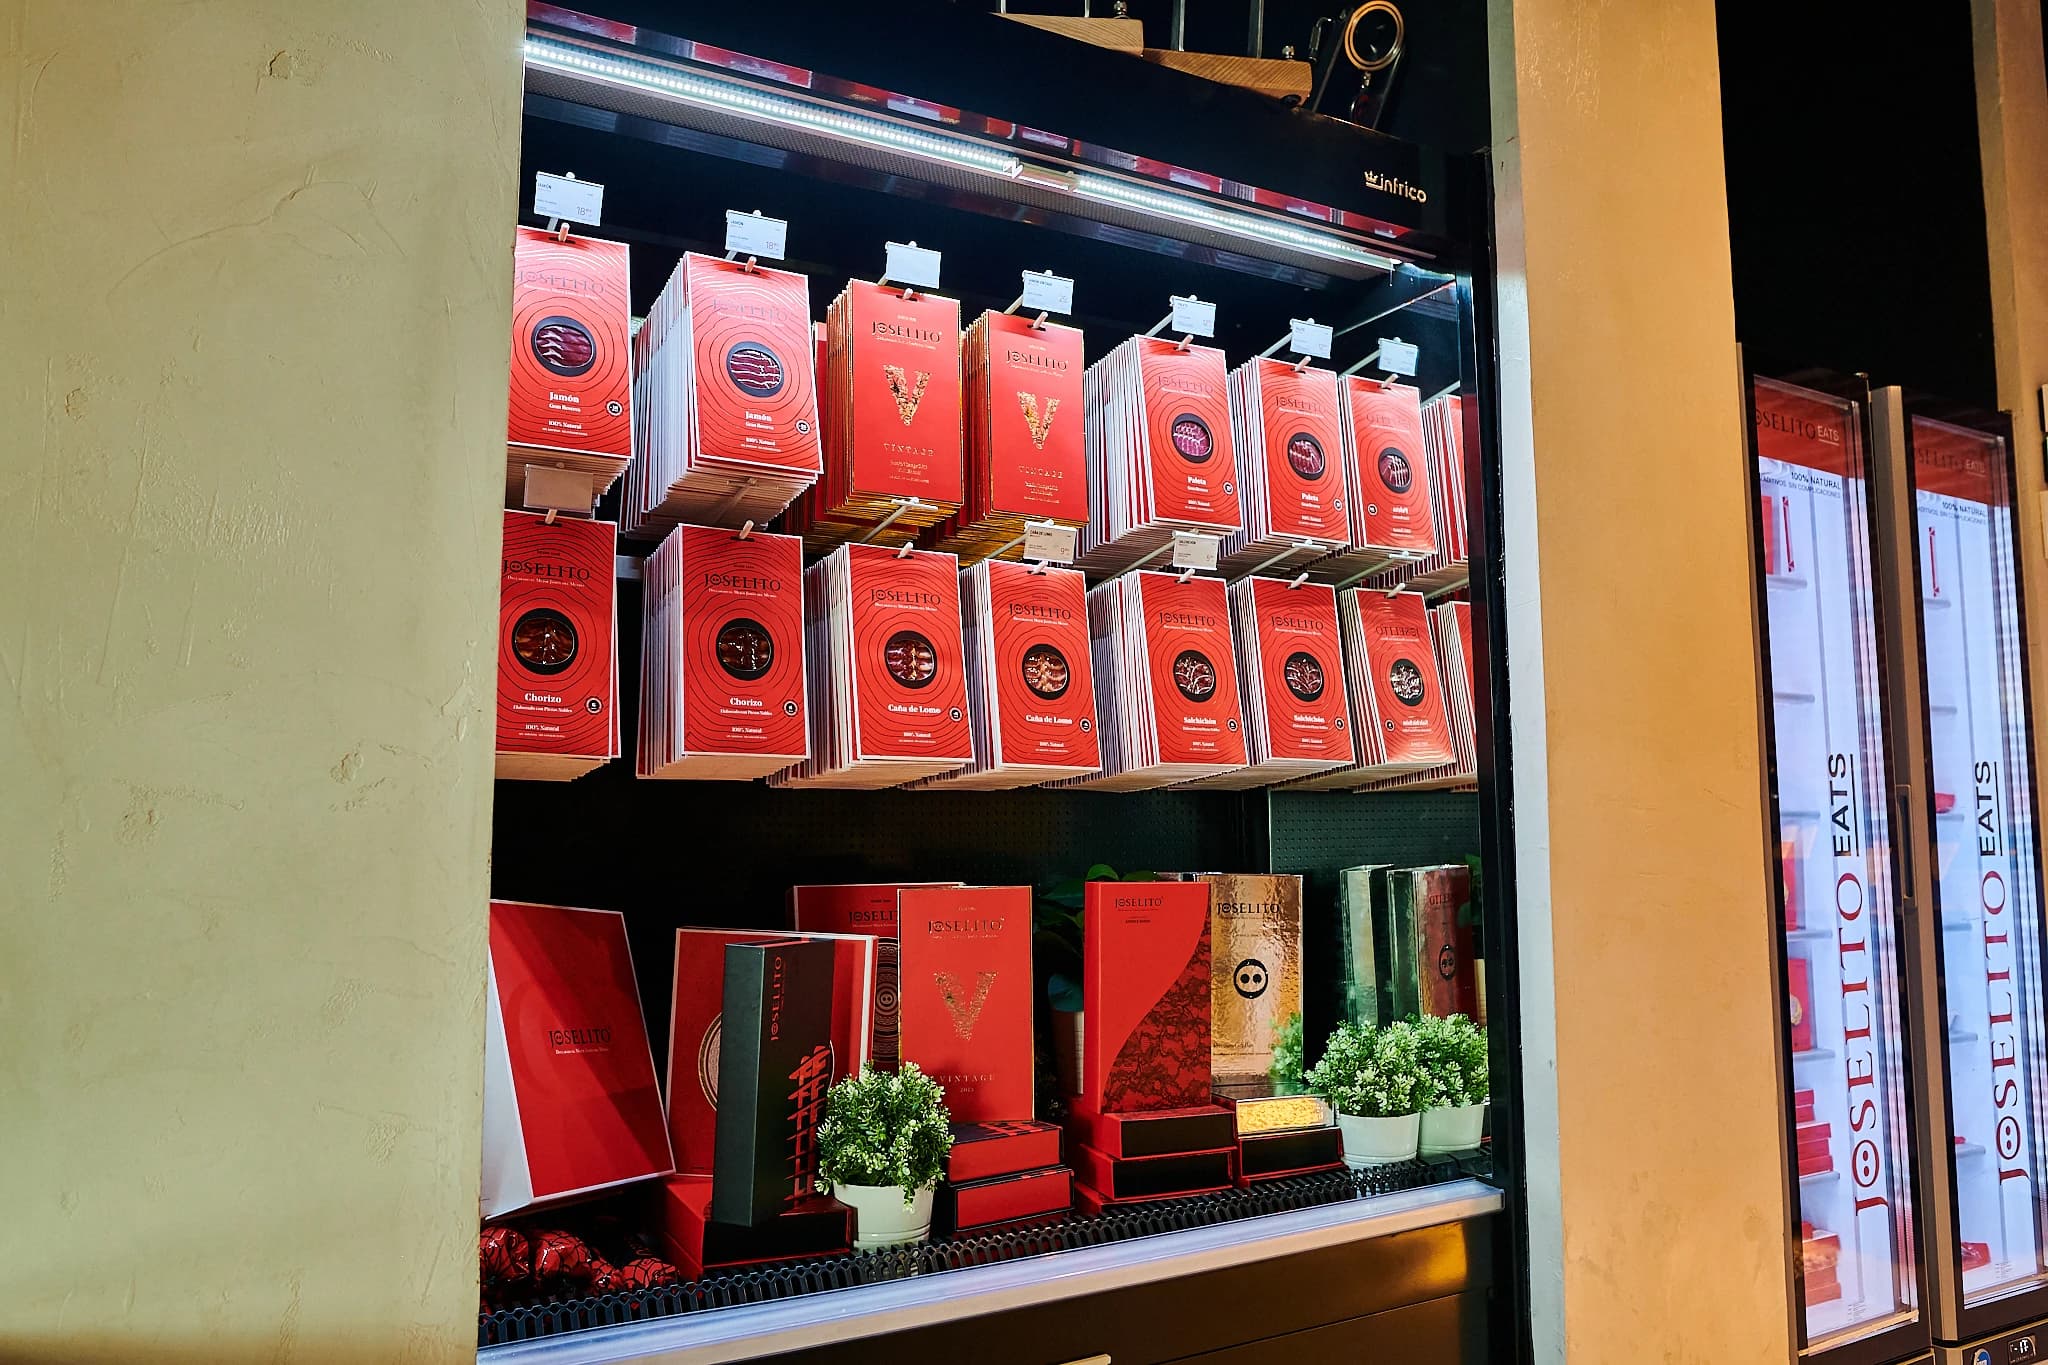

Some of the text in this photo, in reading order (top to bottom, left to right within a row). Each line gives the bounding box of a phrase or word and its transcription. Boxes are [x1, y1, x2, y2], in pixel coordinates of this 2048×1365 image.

[1380, 173, 1427, 204] infrico
[872, 321, 941, 343] JOSELITO
[1006, 350, 1068, 371] JOSELITO
[550, 391, 580, 404] Jamón
[745, 410, 772, 422] Jamón
[1756, 408, 1840, 442] OSELITO EATS
[1187, 476, 1206, 486] Paleta
[1791, 471, 1842, 490] 100% NATURAL
[504, 560, 590, 580] JOSELITO
[704, 573, 781, 592] JOSELITO
[870, 588, 941, 606] JOSELITO
[1009, 603, 1071, 620] JOSELITO
[1159, 612, 1216, 627] JOSELITO
[1270, 616, 1324, 630] JOSELITO
[524, 692, 562, 703] Chorizo
[729, 697, 763, 707] Chorizo
[888, 704, 942, 714] Caña de Lomo
[1025, 714, 1044, 722] Caña
[1054, 716, 1073, 725] Lomo
[1114, 898, 1162, 908] JOSELITO
[1216, 902, 1281, 915] JOSELITO
[848, 910, 898, 923] JOSELI
[928, 920, 1002, 934] JOSELITO
[1975, 761, 2030, 1186] JOSELITO EATS
[1828, 752, 1889, 1216] JOSELITO EATS
[771, 954, 783, 1040] JOSELITO
[548, 1028, 611, 1048] JOSELITO
